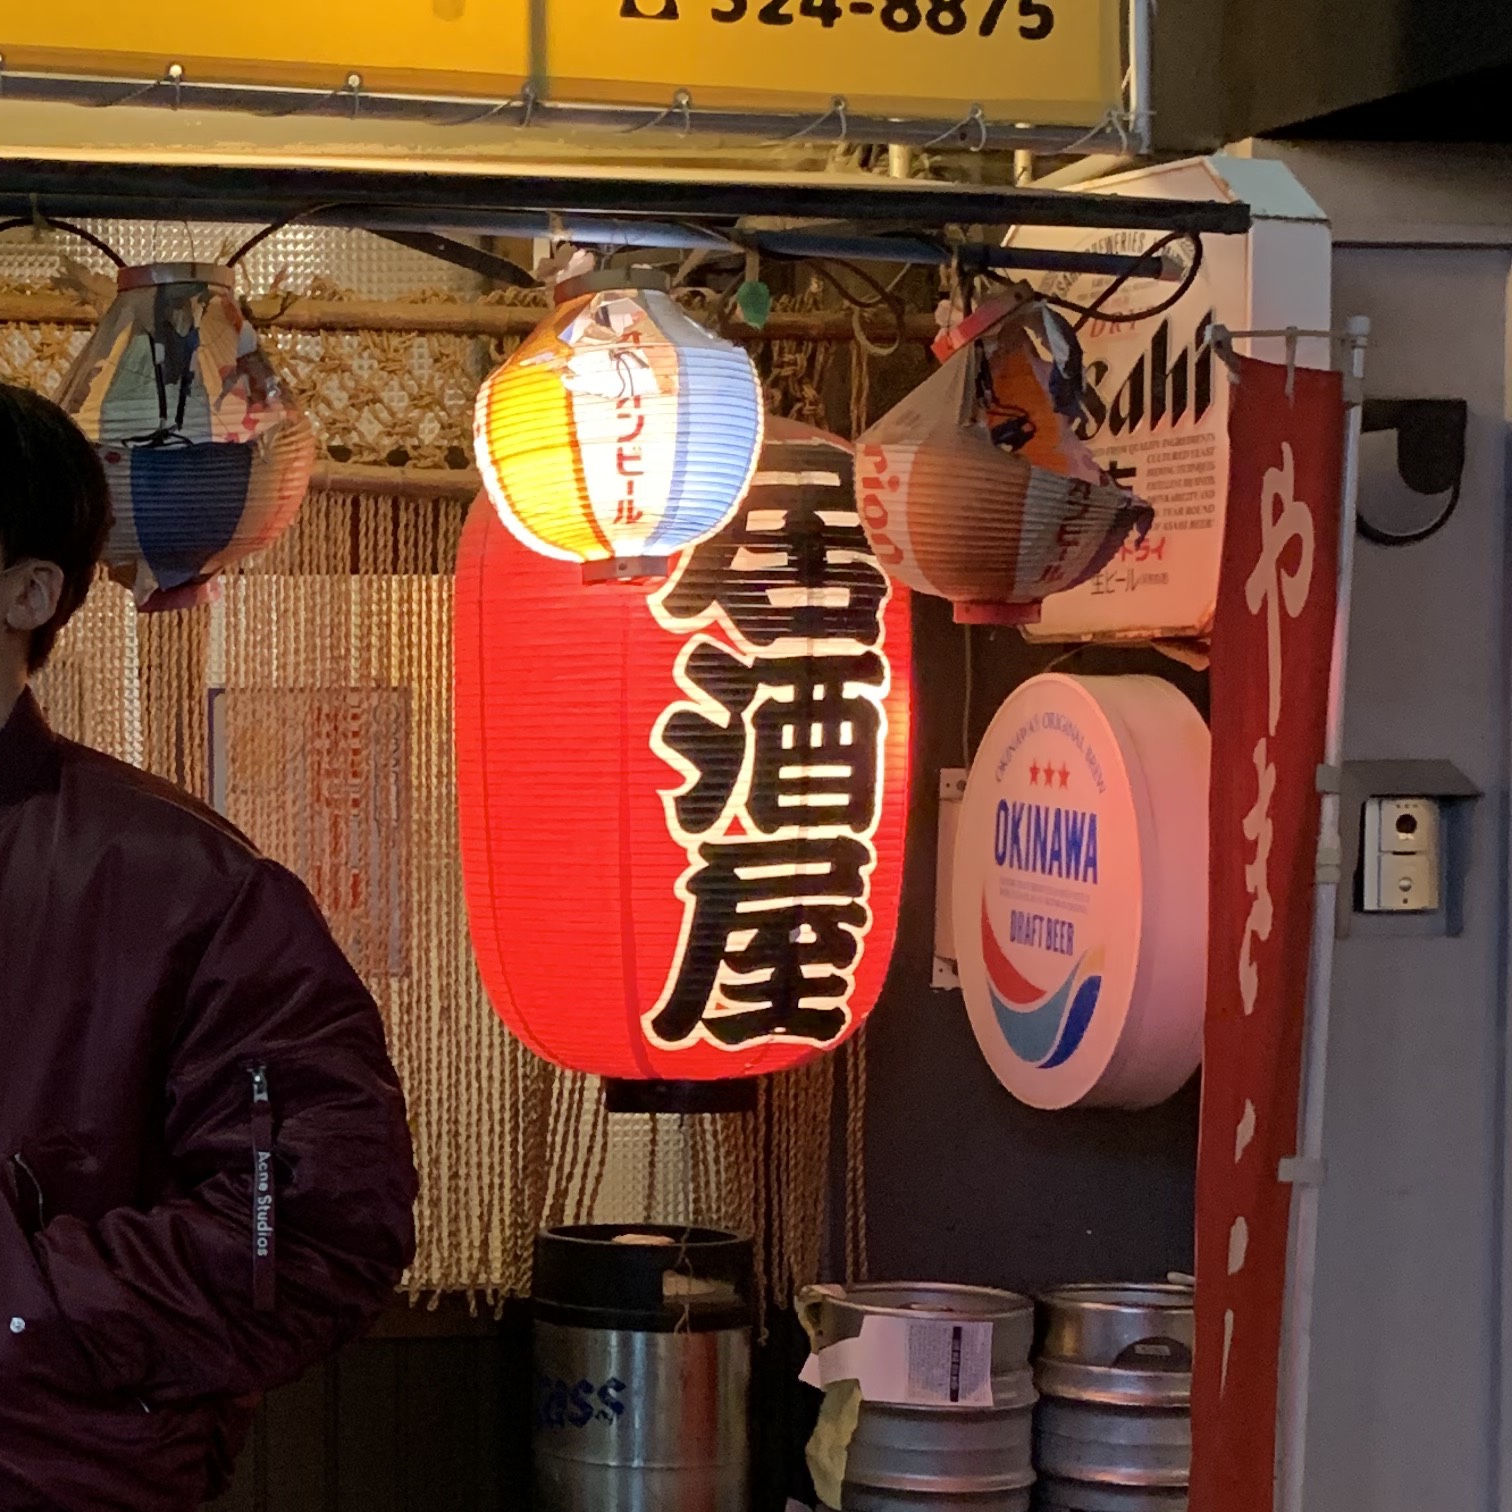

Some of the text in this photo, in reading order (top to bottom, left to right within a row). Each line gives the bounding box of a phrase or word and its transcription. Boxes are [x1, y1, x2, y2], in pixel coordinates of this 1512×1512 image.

[1071, 309, 1214, 441] sahi
[861, 444, 904, 565] rion
[650, 443, 889, 1046] 居酒屋
[994, 798, 1098, 884] OKINAWA
[1009, 909, 1074, 957] DRAFT BEER
[257, 1151, 274, 1257] Acne Studios
